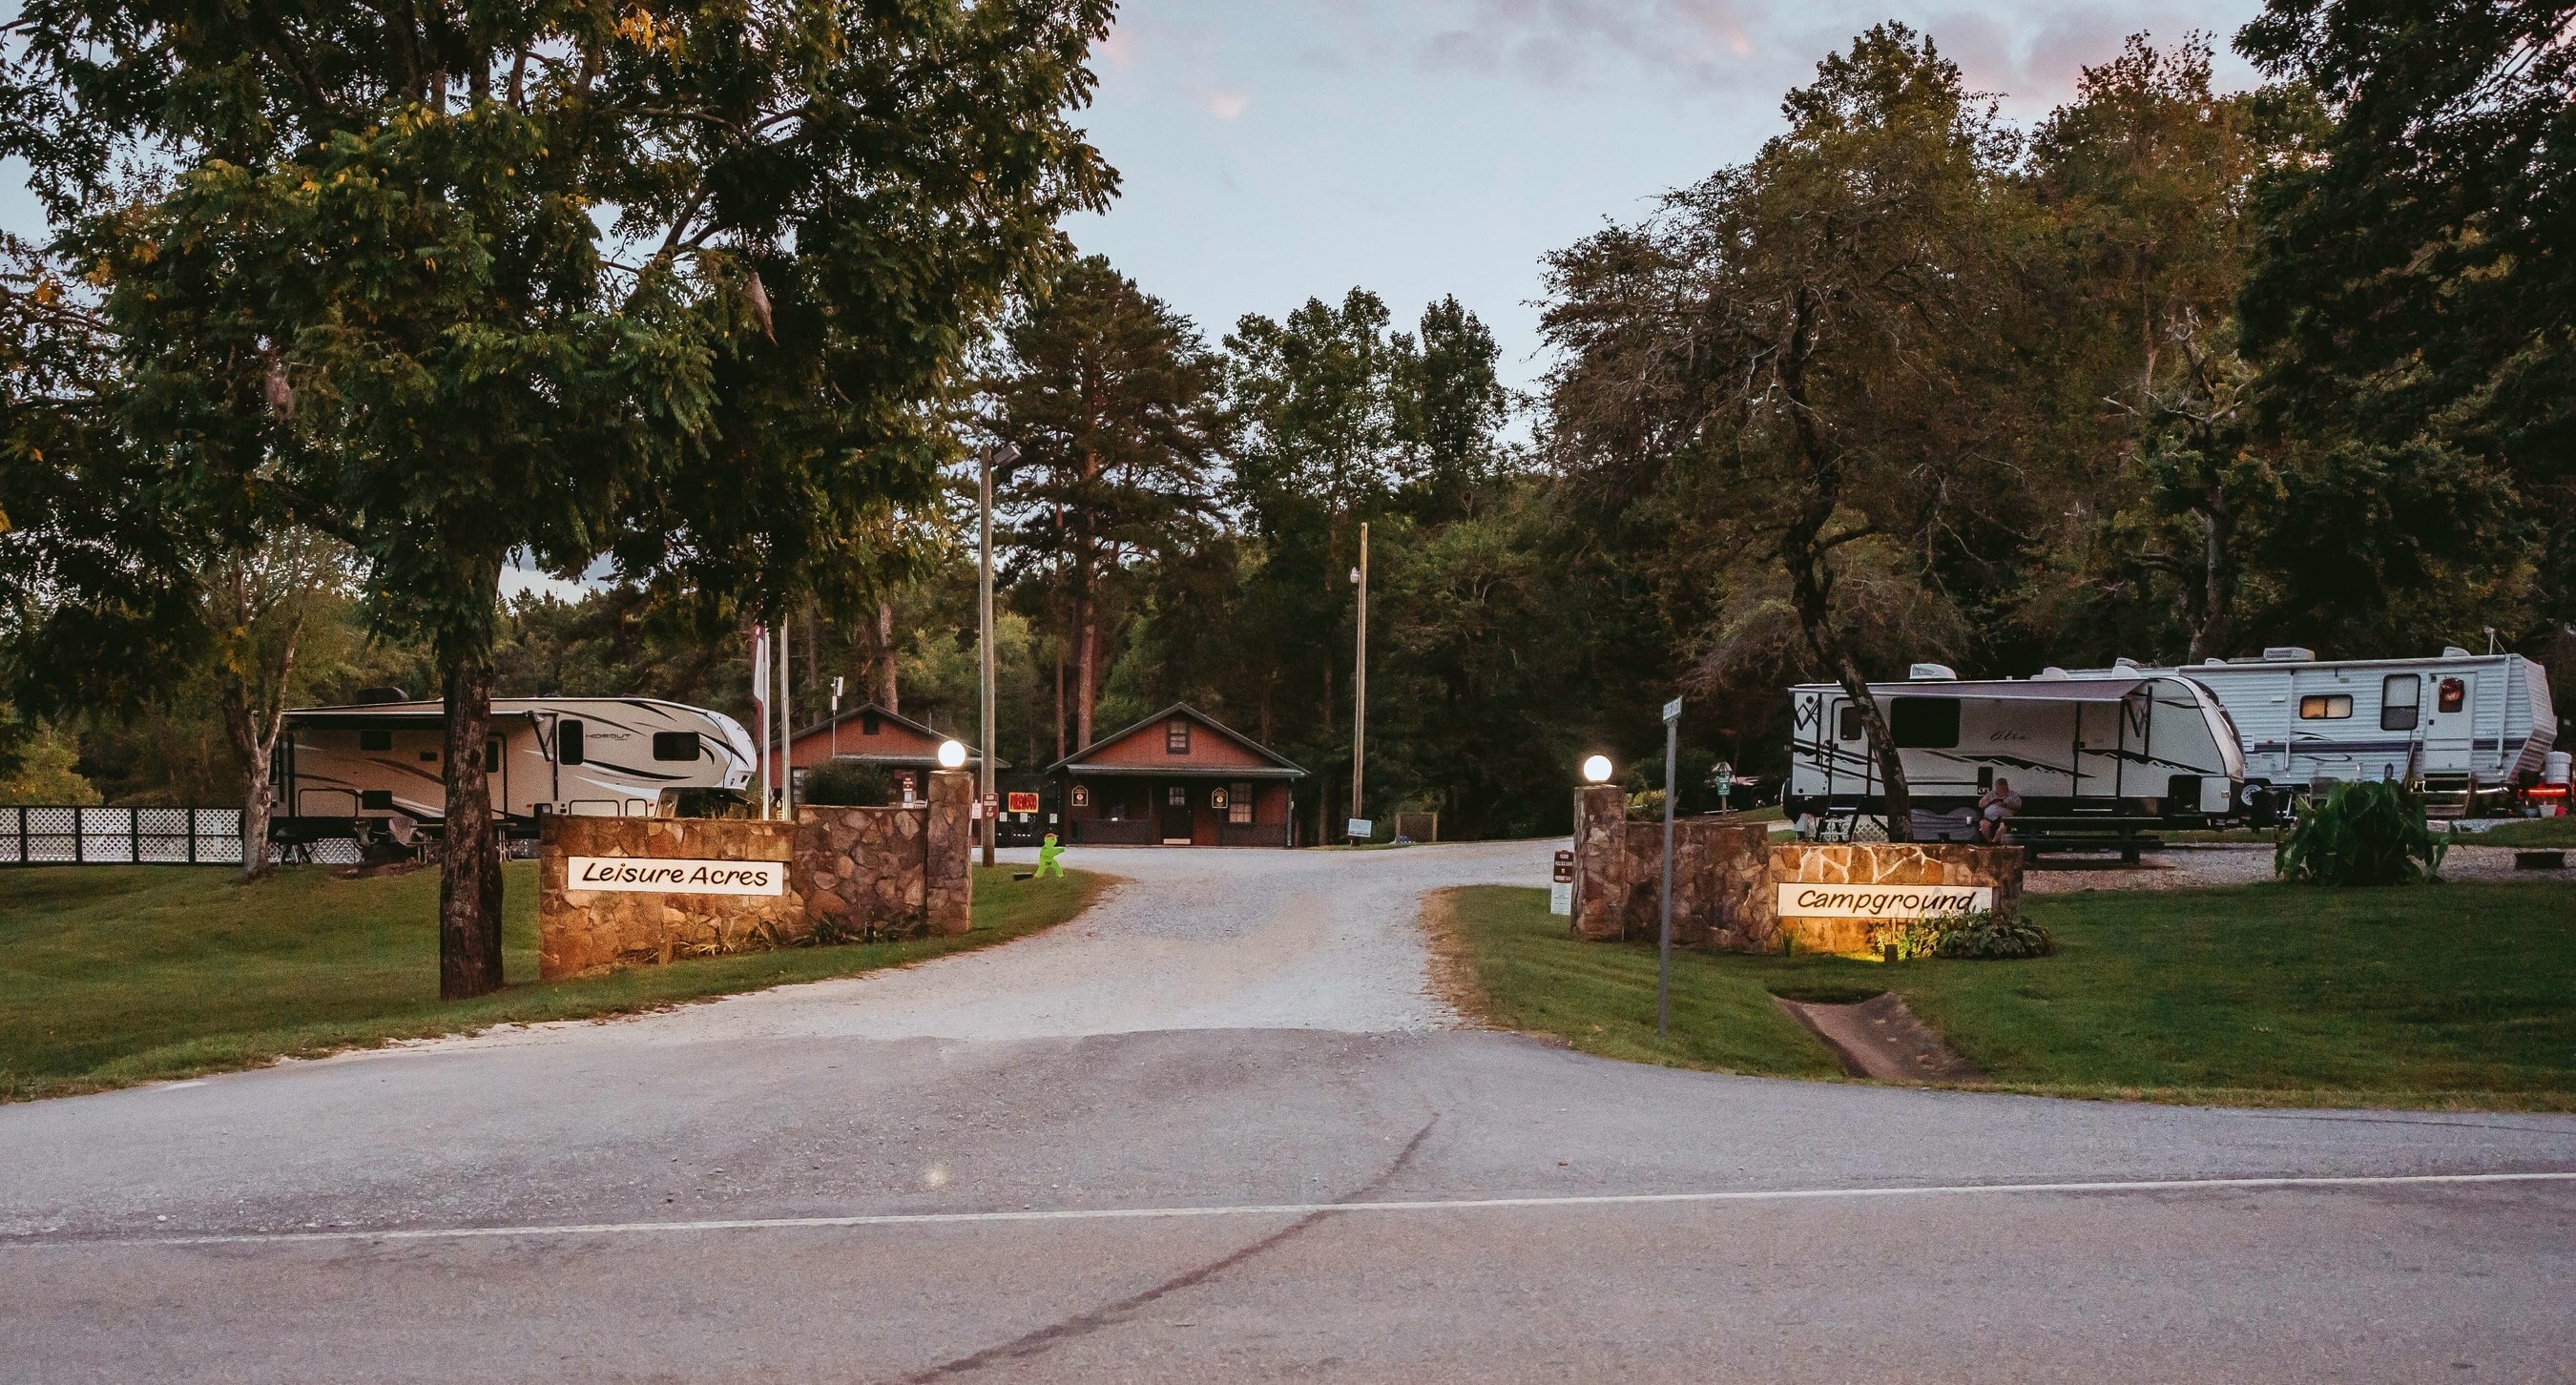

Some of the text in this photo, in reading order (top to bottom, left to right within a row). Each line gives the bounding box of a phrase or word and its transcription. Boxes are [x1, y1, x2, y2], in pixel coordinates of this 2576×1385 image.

[582, 862, 768, 887] Leisure Acres
[1797, 890, 1977, 915] Campground
